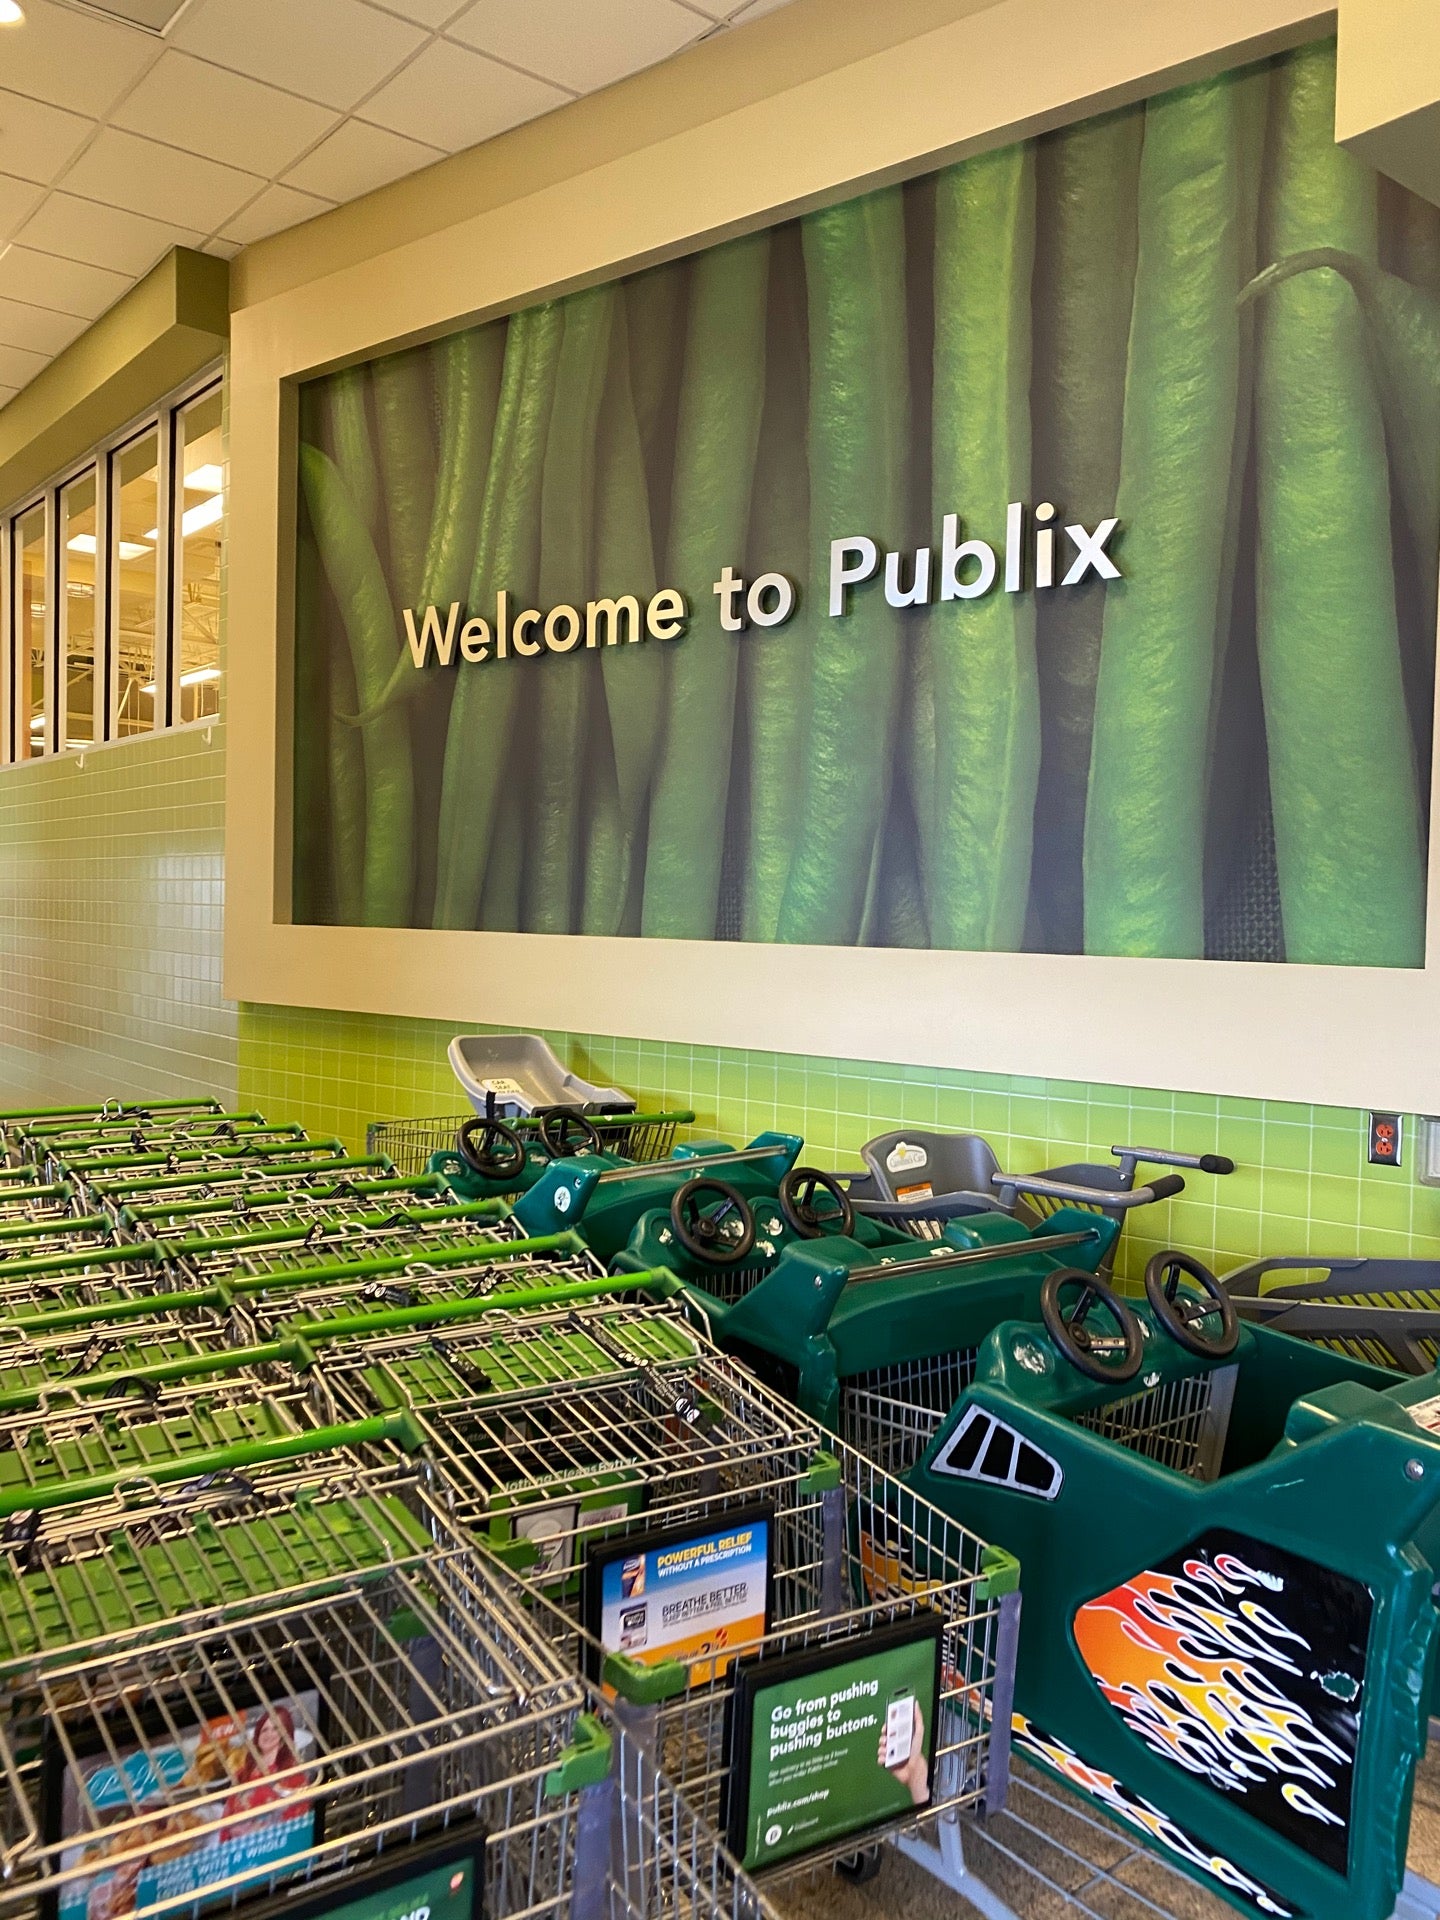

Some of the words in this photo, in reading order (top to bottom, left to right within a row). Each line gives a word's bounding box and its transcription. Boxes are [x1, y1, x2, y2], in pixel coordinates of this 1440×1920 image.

[403, 589, 689, 669] Welcome
[713, 566, 796, 632] to
[829, 501, 1122, 617] Publix
[657, 1541, 716, 1569] POWERFUL
[719, 1531, 752, 1551] RELIEF
[658, 1560, 694, 1578] WITHOUT
[694, 1559, 700, 1568] A
[700, 1543, 752, 1566] PRESCRIPTION
[662, 1593, 708, 1618] BREATHE
[771, 1706, 792, 1722] Go
[795, 1695, 827, 1717] from
[830, 1680, 878, 1709] pushing
[770, 1715, 823, 1740] buggies
[827, 1709, 841, 1723] to
[770, 1732, 822, 1761] pushing
[826, 1714, 878, 1740] buttons.
[767, 1789, 829, 1819] publix.com/shop
[247, 1834, 287, 1858] WHOLE
